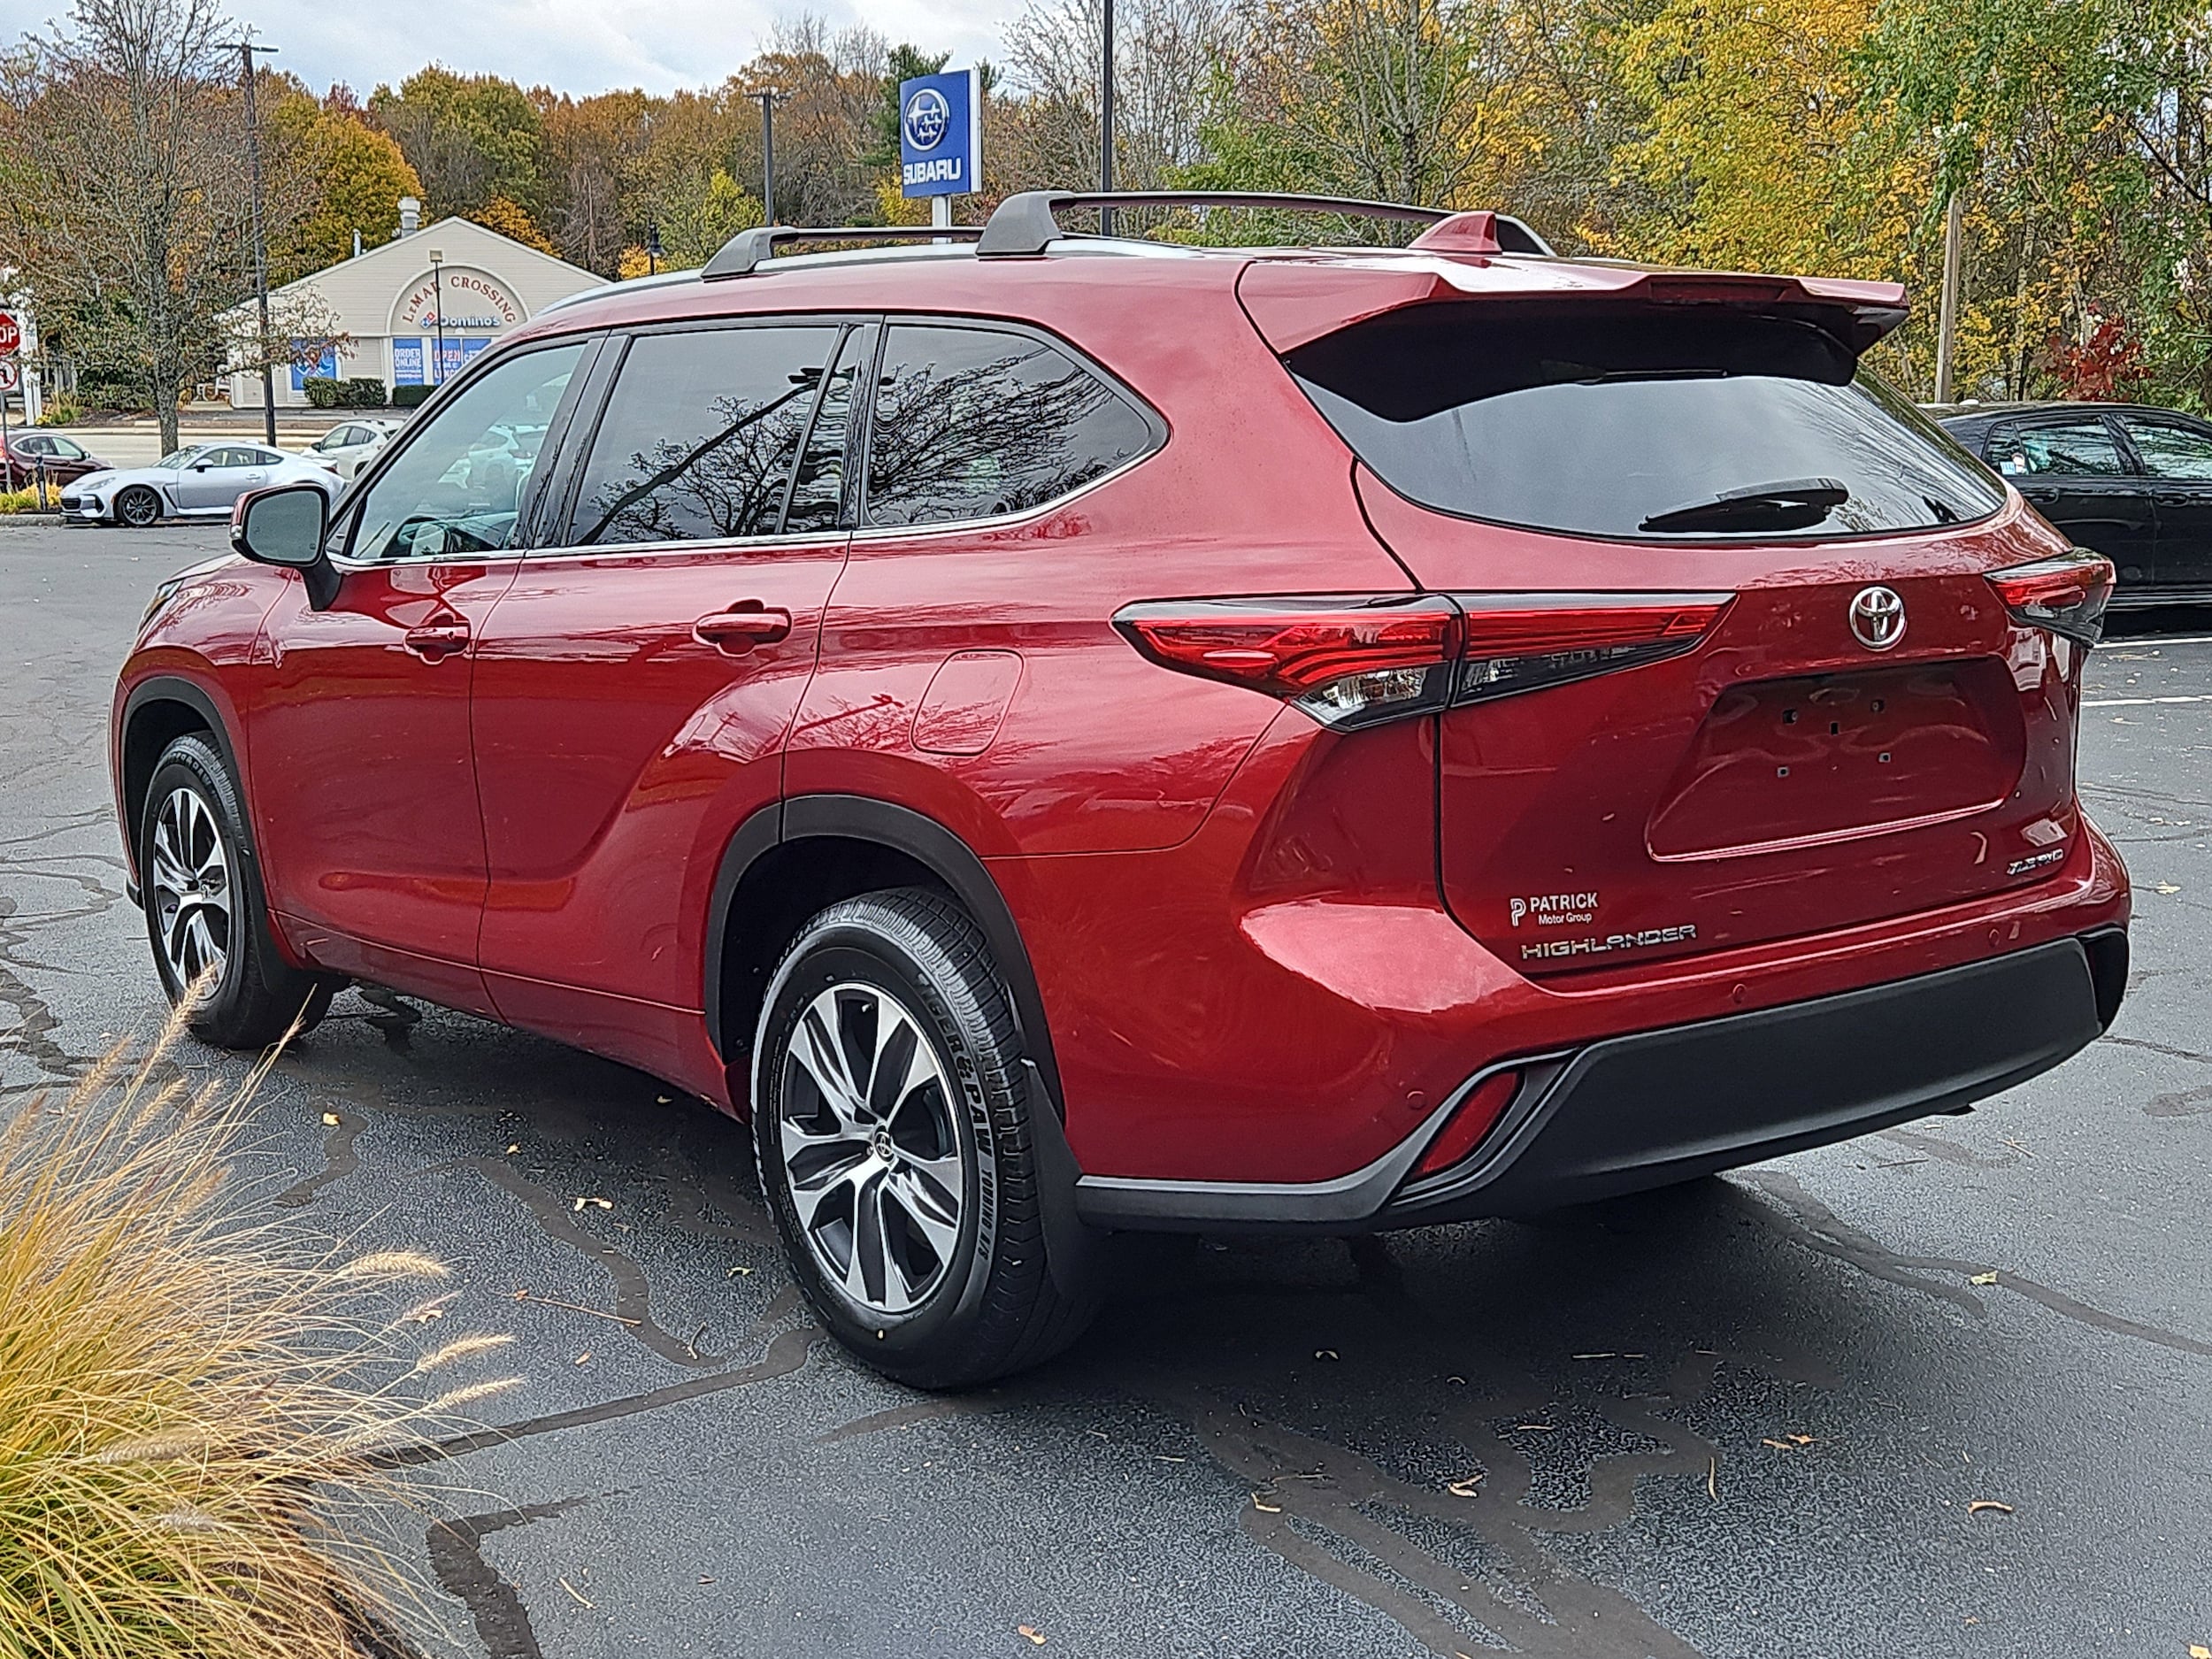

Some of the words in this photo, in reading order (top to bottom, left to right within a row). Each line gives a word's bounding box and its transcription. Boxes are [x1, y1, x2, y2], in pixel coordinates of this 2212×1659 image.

[903, 157, 962, 186] SUBARU
[450, 276, 516, 323] CROSSING
[440, 314, 501, 327] Domino's
[395, 349, 421, 358] ORDER
[395, 358, 422, 367] ONLINE
[1530, 892, 1599, 913] PATRICK
[1539, 913, 1565, 926] Motor
[1566, 911, 1593, 925] Group
[1520, 924, 1697, 960] HIGHLANDER
[963, 1083, 993, 1158] PAW
